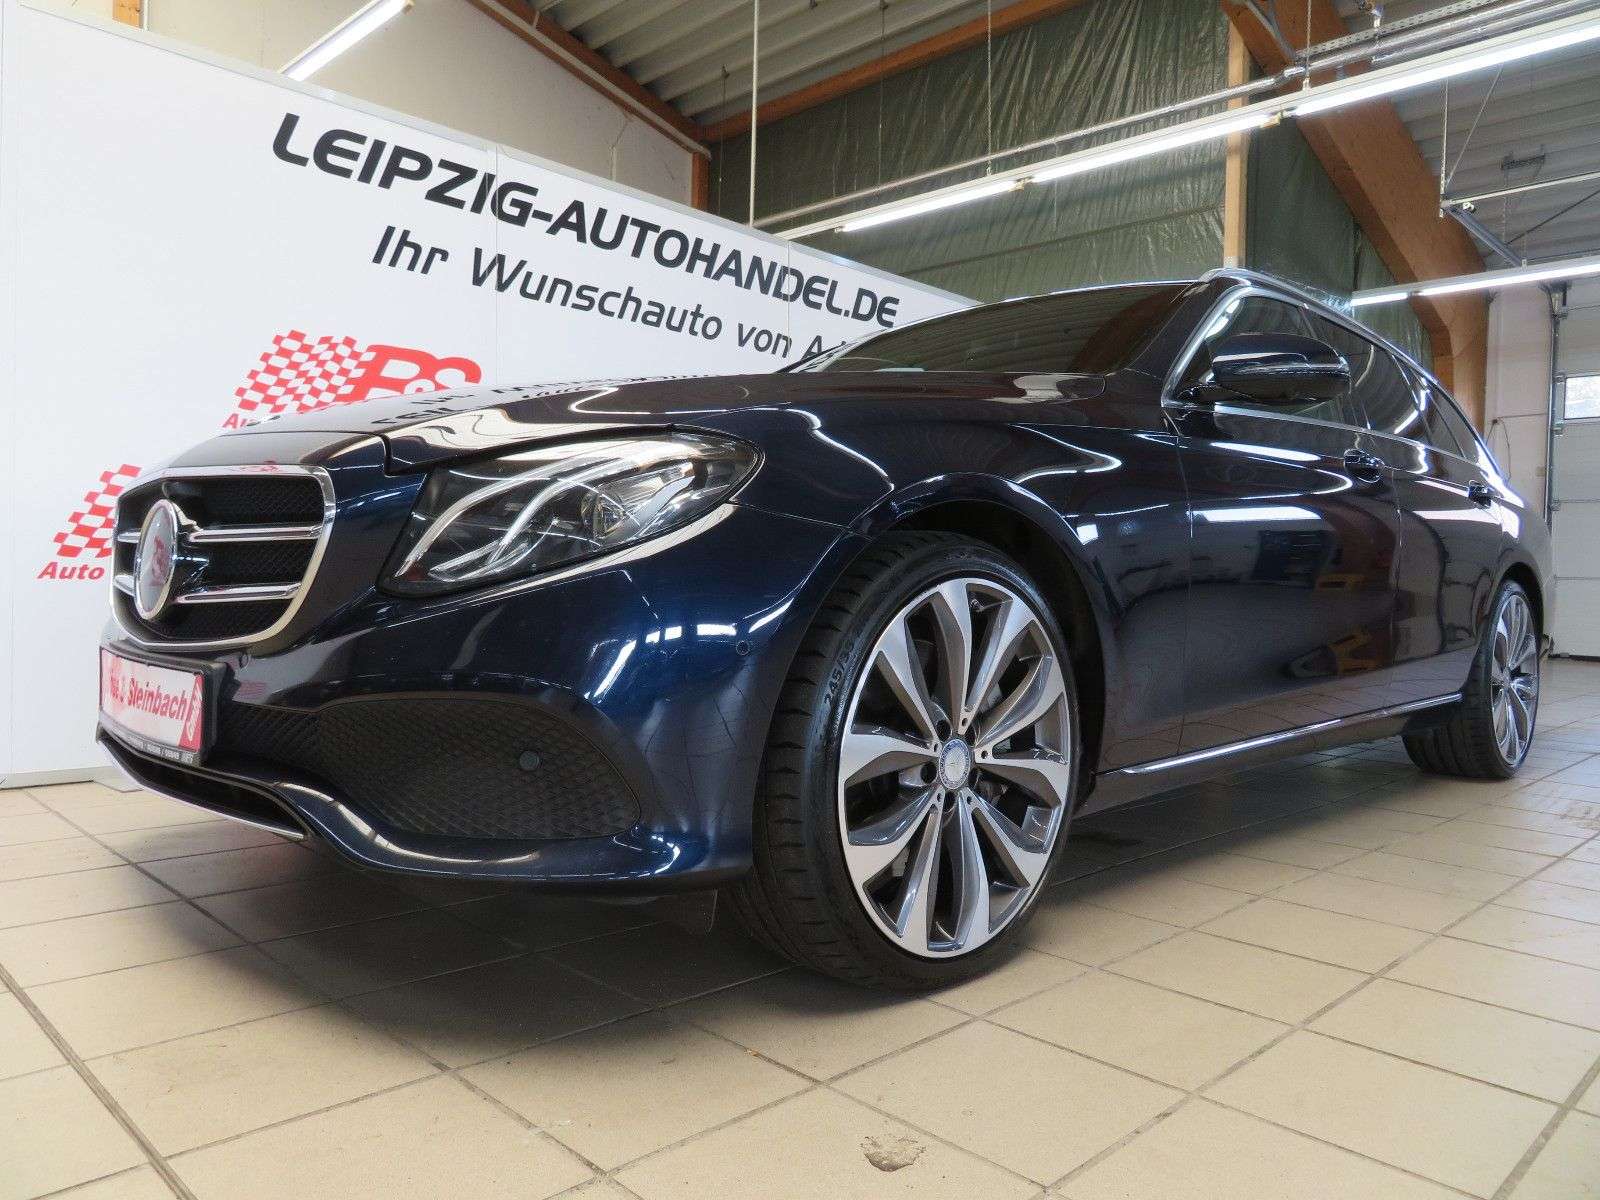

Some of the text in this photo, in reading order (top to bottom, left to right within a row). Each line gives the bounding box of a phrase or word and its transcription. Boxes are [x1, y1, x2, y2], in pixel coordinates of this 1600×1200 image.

[272, 112, 900, 329] LEIPZIG-AUTOHANDEL.DE
[372, 225, 449, 275] Ihr
[473, 246, 723, 341] Wunschauto
[737, 322, 793, 359] von
[37, 561, 105, 580] Auto
[127, 677, 188, 721] Steinbach
